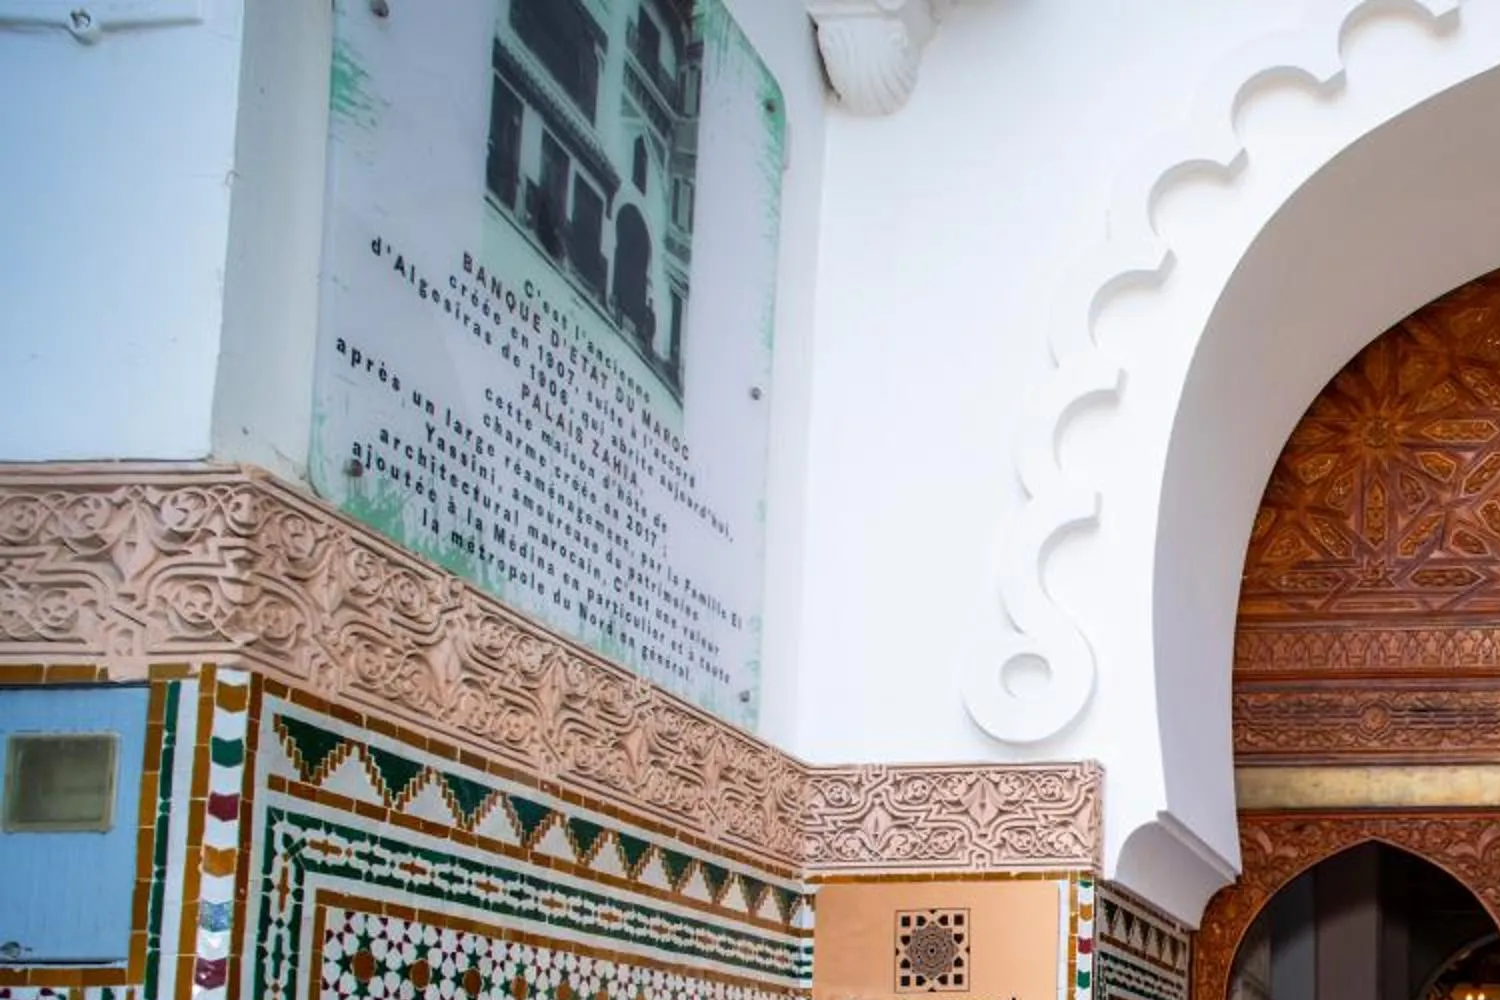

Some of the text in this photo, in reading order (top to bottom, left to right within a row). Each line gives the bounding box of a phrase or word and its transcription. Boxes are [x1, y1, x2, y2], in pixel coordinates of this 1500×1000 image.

[371, 238, 491, 344] d'Algesiras
[501, 343, 520, 367] de
[581, 411, 604, 435] qui
[611, 435, 653, 475] abrite
[449, 275, 500, 324] créée
[510, 326, 528, 348] en
[538, 344, 580, 393] 1907,
[587, 390, 622, 427] suite
[463, 252, 688, 460] BANQUE D'ETAT DU MAROC
[524, 280, 567, 329] C'est
[336, 338, 399, 390] après
[412, 391, 434, 415] un
[445, 408, 494, 456] large
[640, 551, 661, 571] par
[667, 566, 678, 586] la
[483, 414, 545, 466] charme
[604, 502, 618, 519] en
[626, 514, 656, 546] 2017
[485, 388, 532, 430] cette
[541, 430, 594, 478] maison
[653, 513, 666, 533] de
[521, 383, 582, 444] PALAIS
[352, 442, 436, 502] ajoutée
[467, 507, 482, 533] la
[493, 523, 554, 575] Médina
[562, 572, 579, 590] en
[587, 587, 664, 641] particulier
[670, 639, 682, 654] et
[699, 656, 729, 683] toute
[380, 429, 518, 524] architectural
[655, 607, 676, 628] une
[683, 626, 719, 653] valeur
[422, 508, 439, 534] la
[451, 531, 544, 594] métropole
[553, 588, 570, 610] du
[578, 602, 613, 635] Nord
[620, 631, 634, 648] en
[605, 548, 621, 569] du
[628, 567, 697, 620] patrimoine
